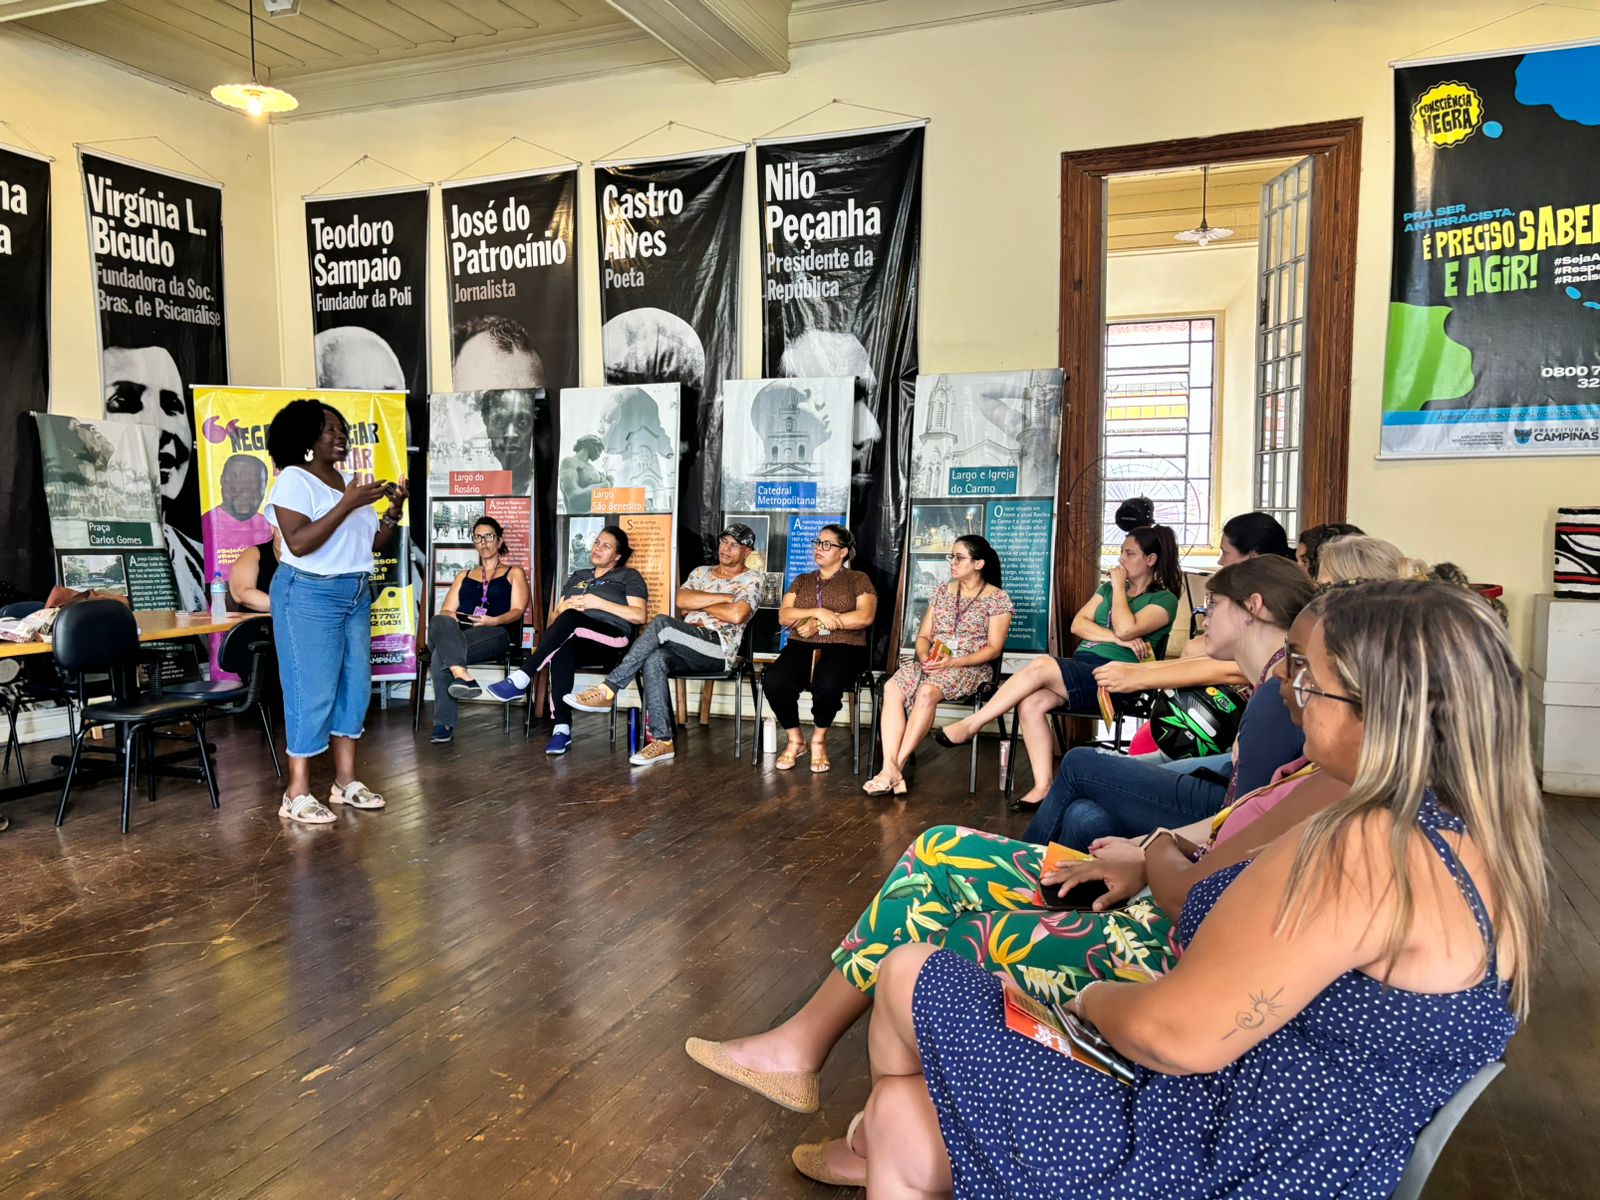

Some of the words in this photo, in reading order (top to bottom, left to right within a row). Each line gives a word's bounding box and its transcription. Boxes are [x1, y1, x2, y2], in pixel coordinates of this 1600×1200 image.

[1422, 108, 1474, 136] NEGRA
[765, 160, 816, 201] Nilo
[87, 172, 180, 230] Virgínia
[185, 198, 207, 237] L.
[603, 181, 684, 222] Castro
[1403, 209, 1434, 222] PRA
[1436, 203, 1466, 217] SER
[451, 200, 498, 240] José
[502, 197, 530, 233] do
[766, 198, 881, 249] Peçanha
[91, 215, 175, 268] Bicudo
[311, 216, 394, 251] Teodoro
[604, 226, 667, 261] Alves
[453, 231, 567, 276] Patrocínio
[1422, 233, 1432, 260] É
[314, 249, 401, 289] Sampaio
[767, 249, 849, 275] Presidente
[853, 248, 874, 270] da
[97, 262, 165, 296] Fundadora
[168, 272, 185, 297] da
[187, 278, 215, 302] Soc.
[454, 279, 516, 304] Jornalista
[605, 268, 645, 290] Poeta
[767, 277, 840, 302] República
[1444, 261, 1459, 297] E
[97, 289, 132, 315] Bras.
[135, 294, 152, 319] de
[155, 299, 221, 328] Psicanálise
[316, 290, 370, 312] Fundador
[372, 288, 387, 309] da
[389, 286, 412, 307] Poli
[1541, 366, 1589, 378] 0800
[1577, 378, 1600, 389] 32
[1534, 431, 1599, 442] CAMPINAS
[454, 472, 473, 484] Largo
[475, 472, 484, 481] do
[953, 469, 977, 482] Largo
[980, 471, 986, 479] e
[988, 468, 1015, 481] Igreja
[454, 484, 480, 494] Rosário
[593, 489, 614, 500] Largo
[757, 485, 792, 496] Catedral
[757, 495, 816, 506] Metropolitana
[951, 483, 963, 494] do
[965, 483, 996, 494] Carmo
[592, 501, 607, 511] São
[608, 501, 642, 511] Benedito
[88, 521, 111, 534] Praça
[90, 534, 116, 545] Carlos
[116, 534, 143, 545] Gomes
